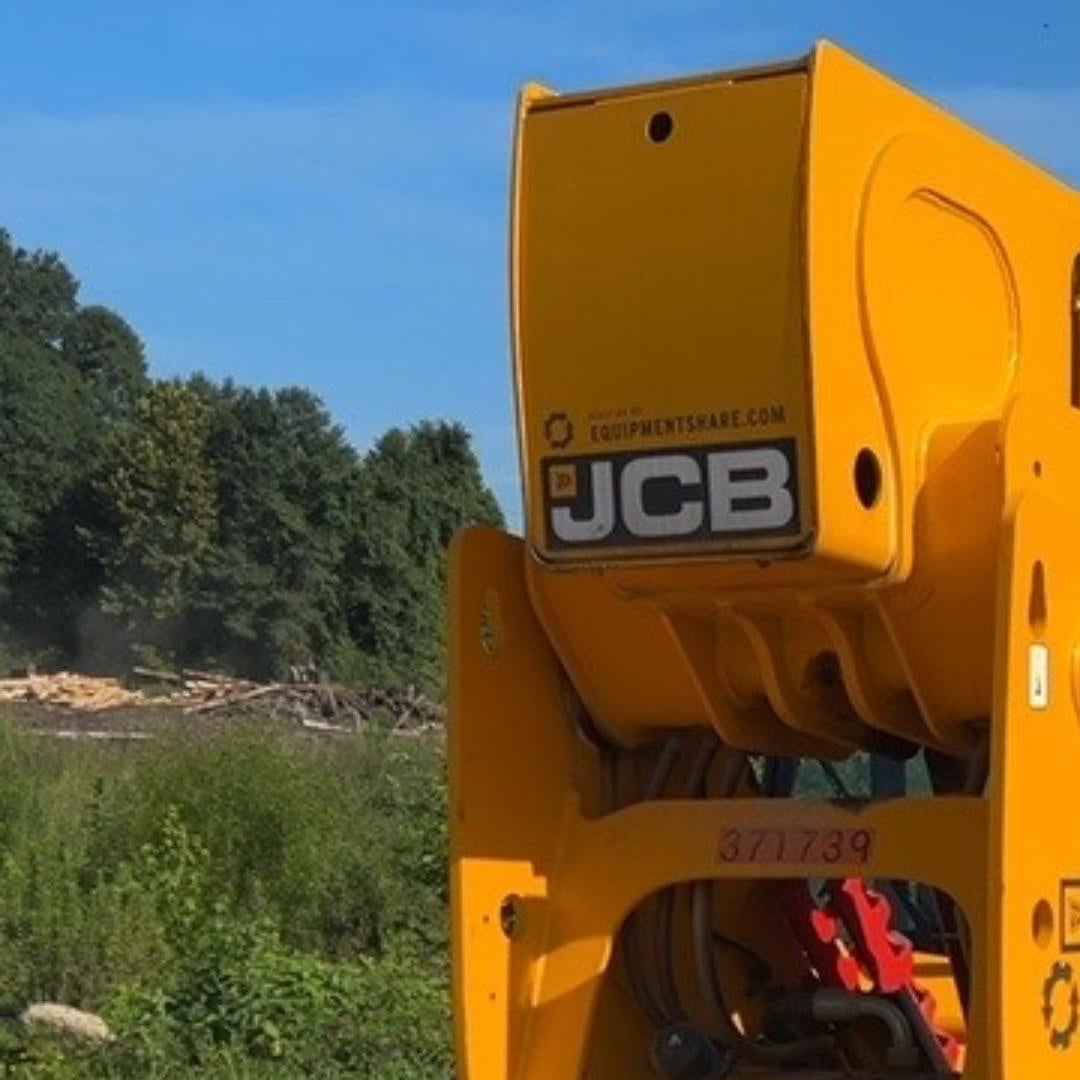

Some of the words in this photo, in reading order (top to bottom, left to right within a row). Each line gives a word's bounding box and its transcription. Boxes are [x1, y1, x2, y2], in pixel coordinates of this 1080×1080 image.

[589, 403, 786, 443] EQUIPMENTSHARE.COM
[551, 447, 794, 542] JCB
[719, 825, 874, 864] 371739
